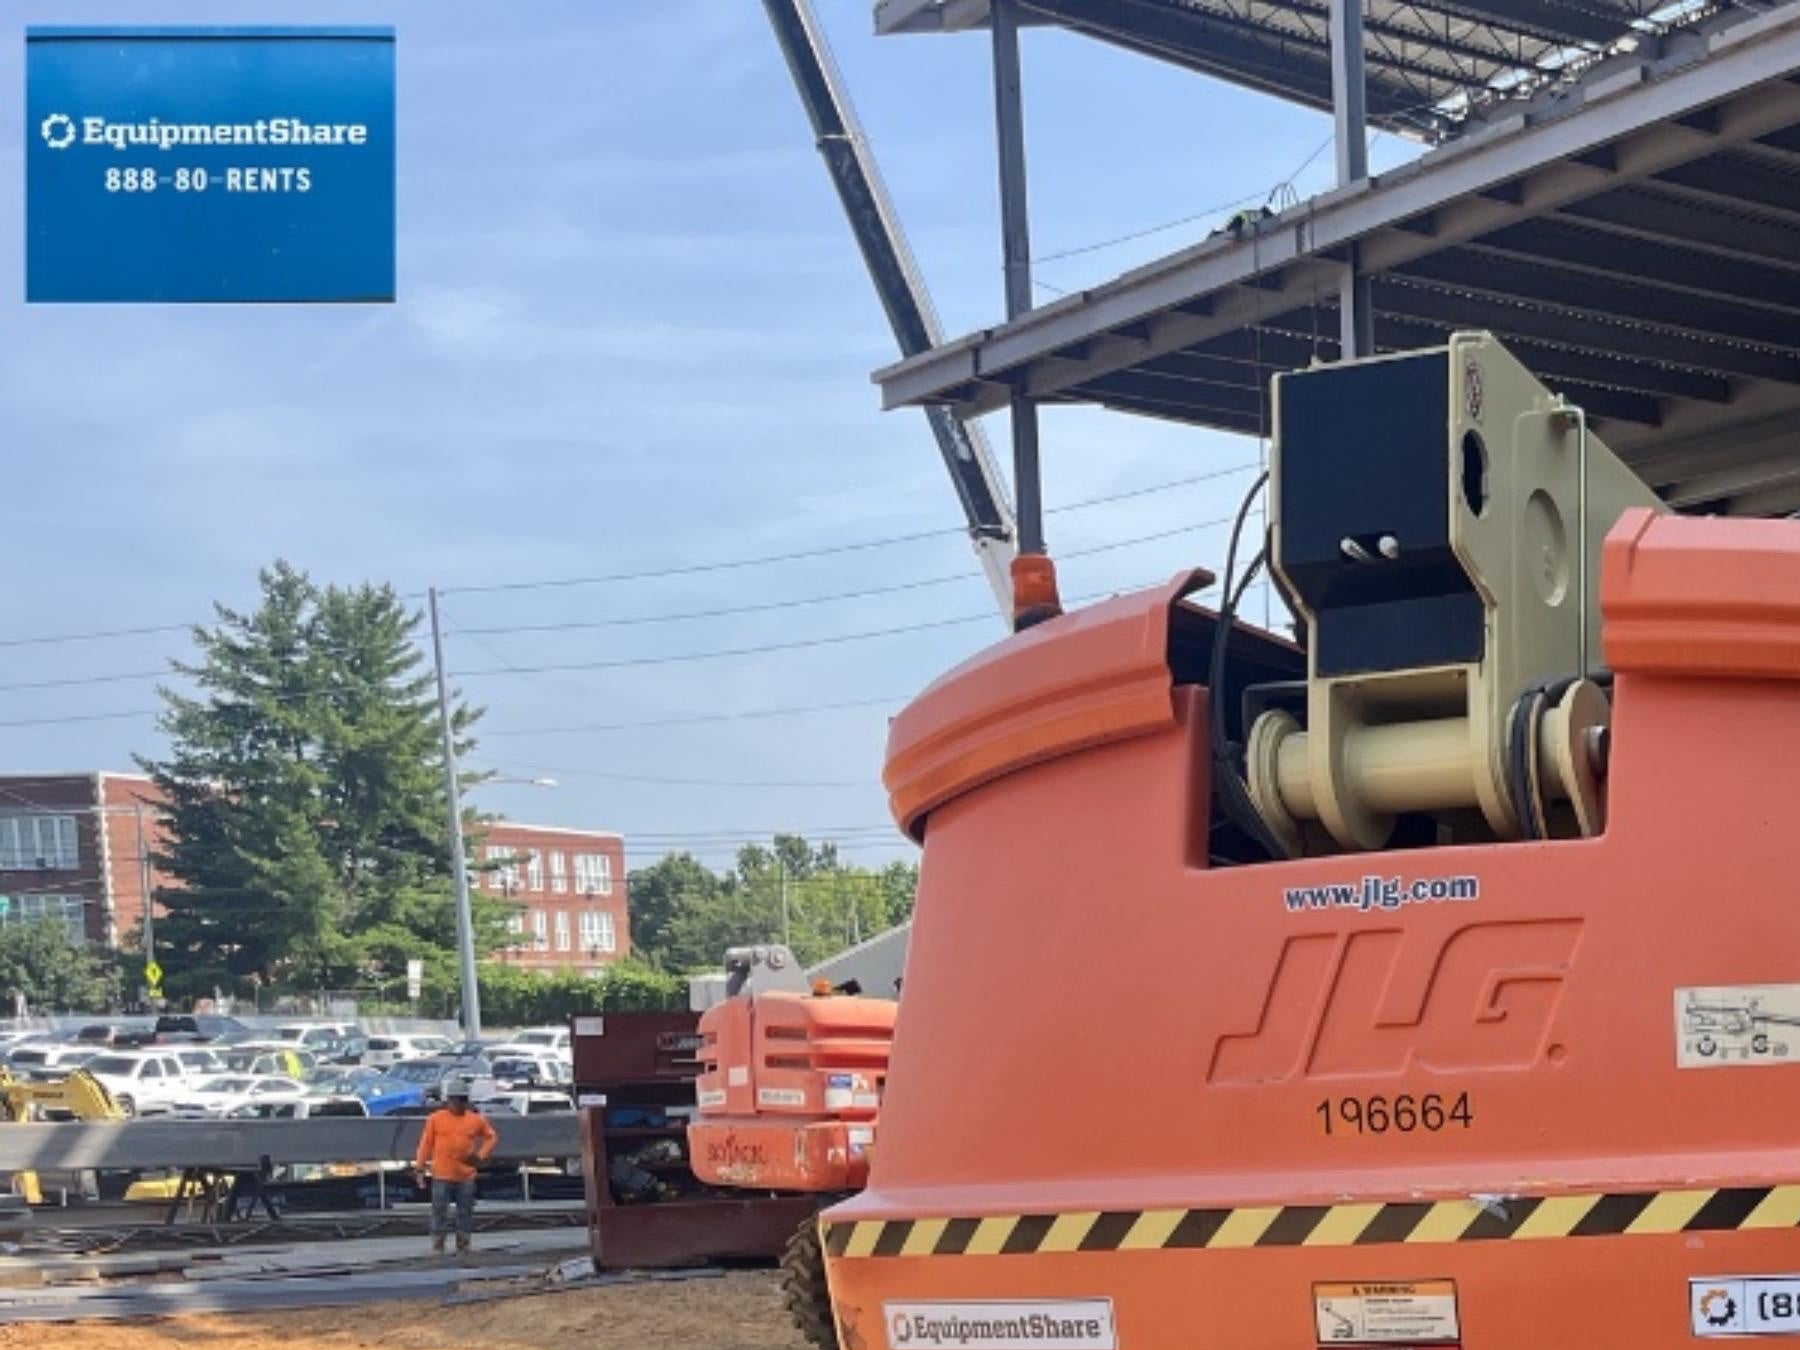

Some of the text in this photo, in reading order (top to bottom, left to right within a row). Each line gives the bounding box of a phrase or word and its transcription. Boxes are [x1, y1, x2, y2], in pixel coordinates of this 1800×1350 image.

[1285, 875, 1479, 911] www.jlg.com
[1316, 1091, 1474, 1135] 196664
[913, 1314, 1102, 1345] EquipmentShare
